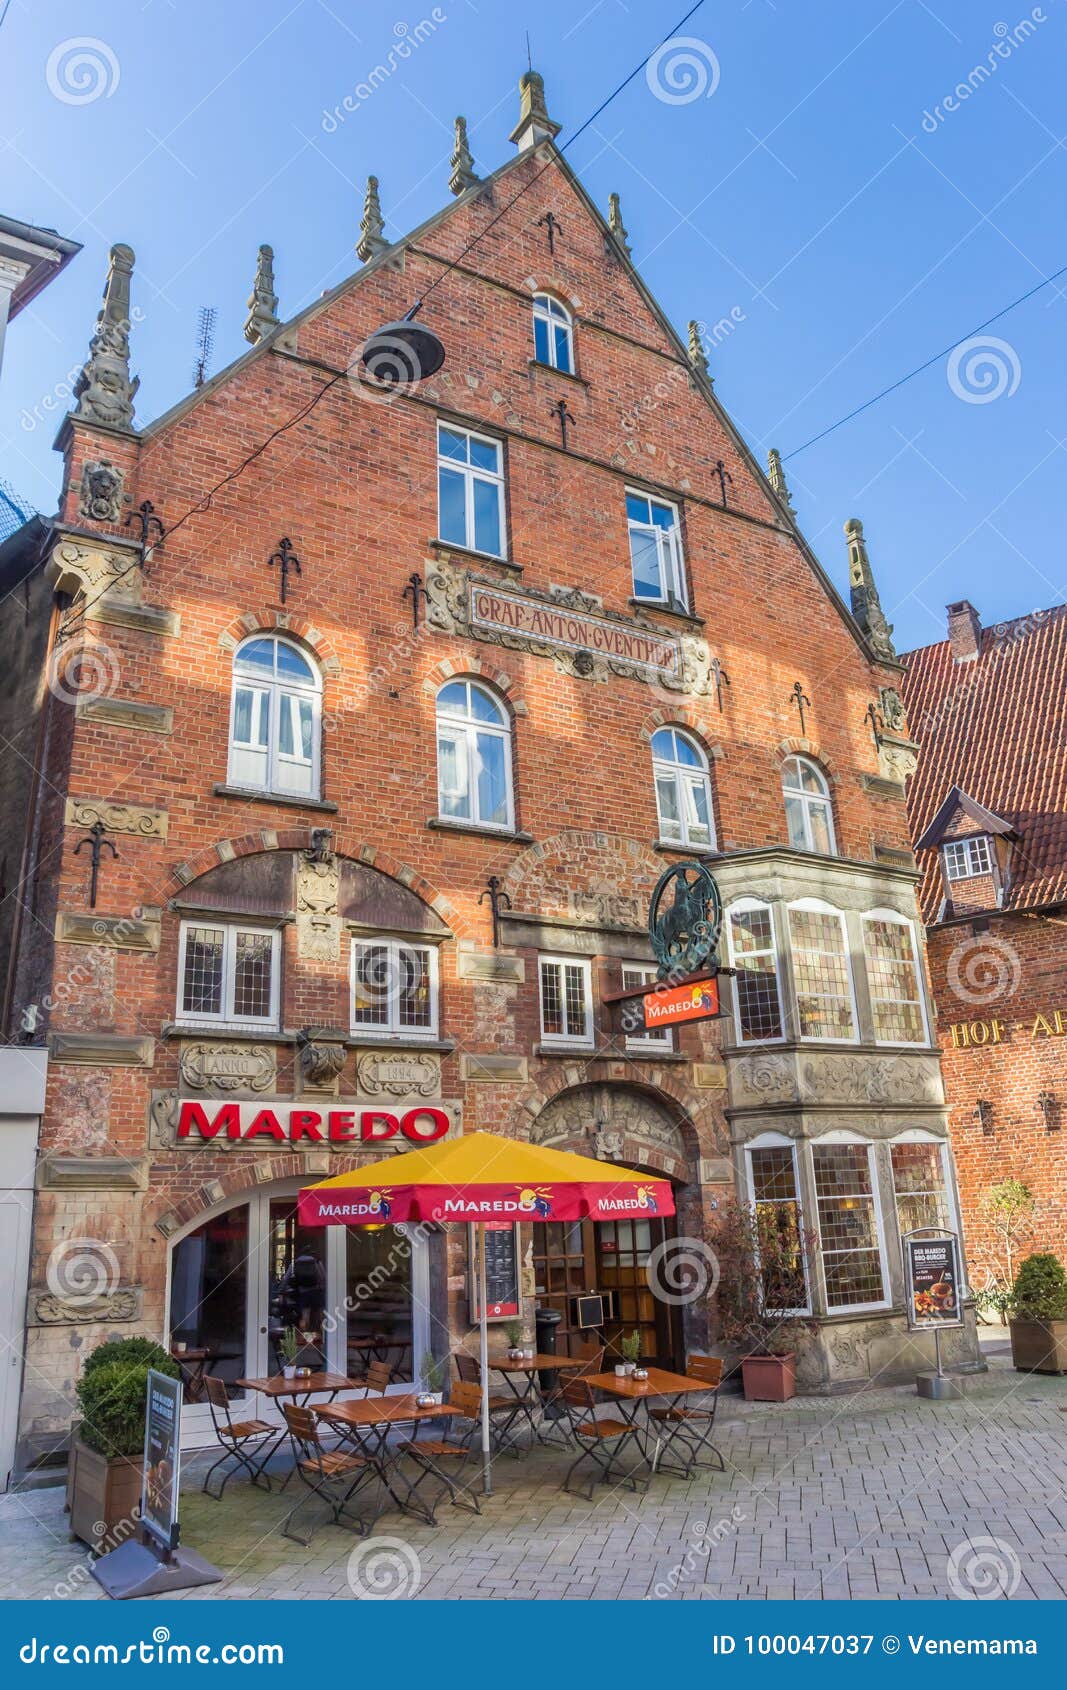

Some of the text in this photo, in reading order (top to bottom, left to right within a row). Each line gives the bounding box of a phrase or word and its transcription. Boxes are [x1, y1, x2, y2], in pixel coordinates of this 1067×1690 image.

[531, 610, 588, 646] ANTON
[648, 996, 703, 1018] MAREDO
[950, 1019, 1005, 1048] HOF
[177, 1102, 450, 1141] MAREDO
[319, 1202, 381, 1217] MAREDO
[445, 1200, 536, 1212] MAREDO
[598, 1198, 648, 1211] MAREDO
